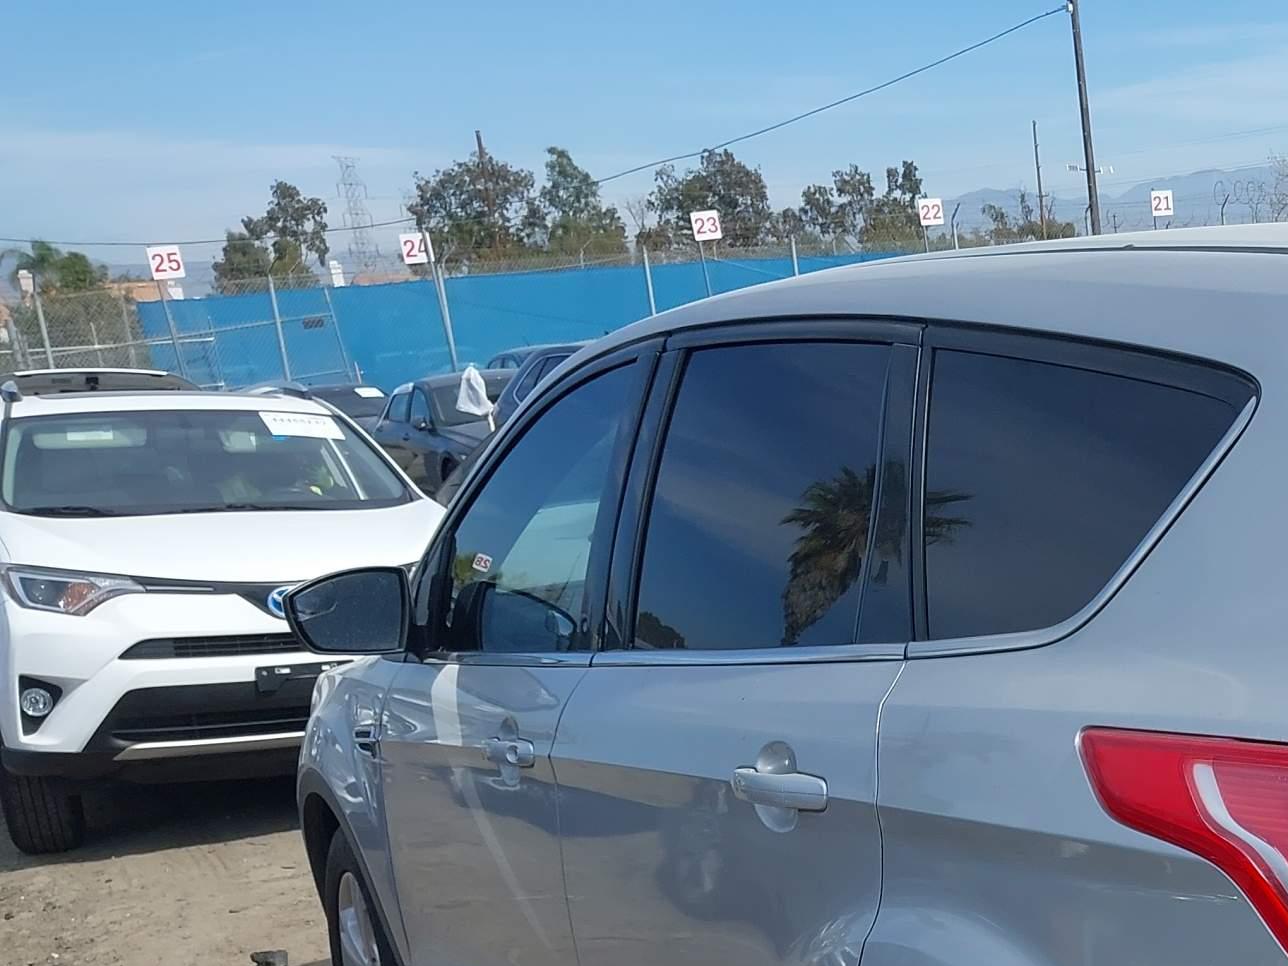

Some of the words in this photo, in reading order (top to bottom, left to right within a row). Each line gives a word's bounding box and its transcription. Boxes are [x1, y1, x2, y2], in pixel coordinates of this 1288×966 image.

[921, 204, 942, 220] 22
[1153, 195, 1172, 211] 21
[694, 216, 718, 234] 23
[403, 239, 428, 258] 24
[151, 252, 181, 273] 25
